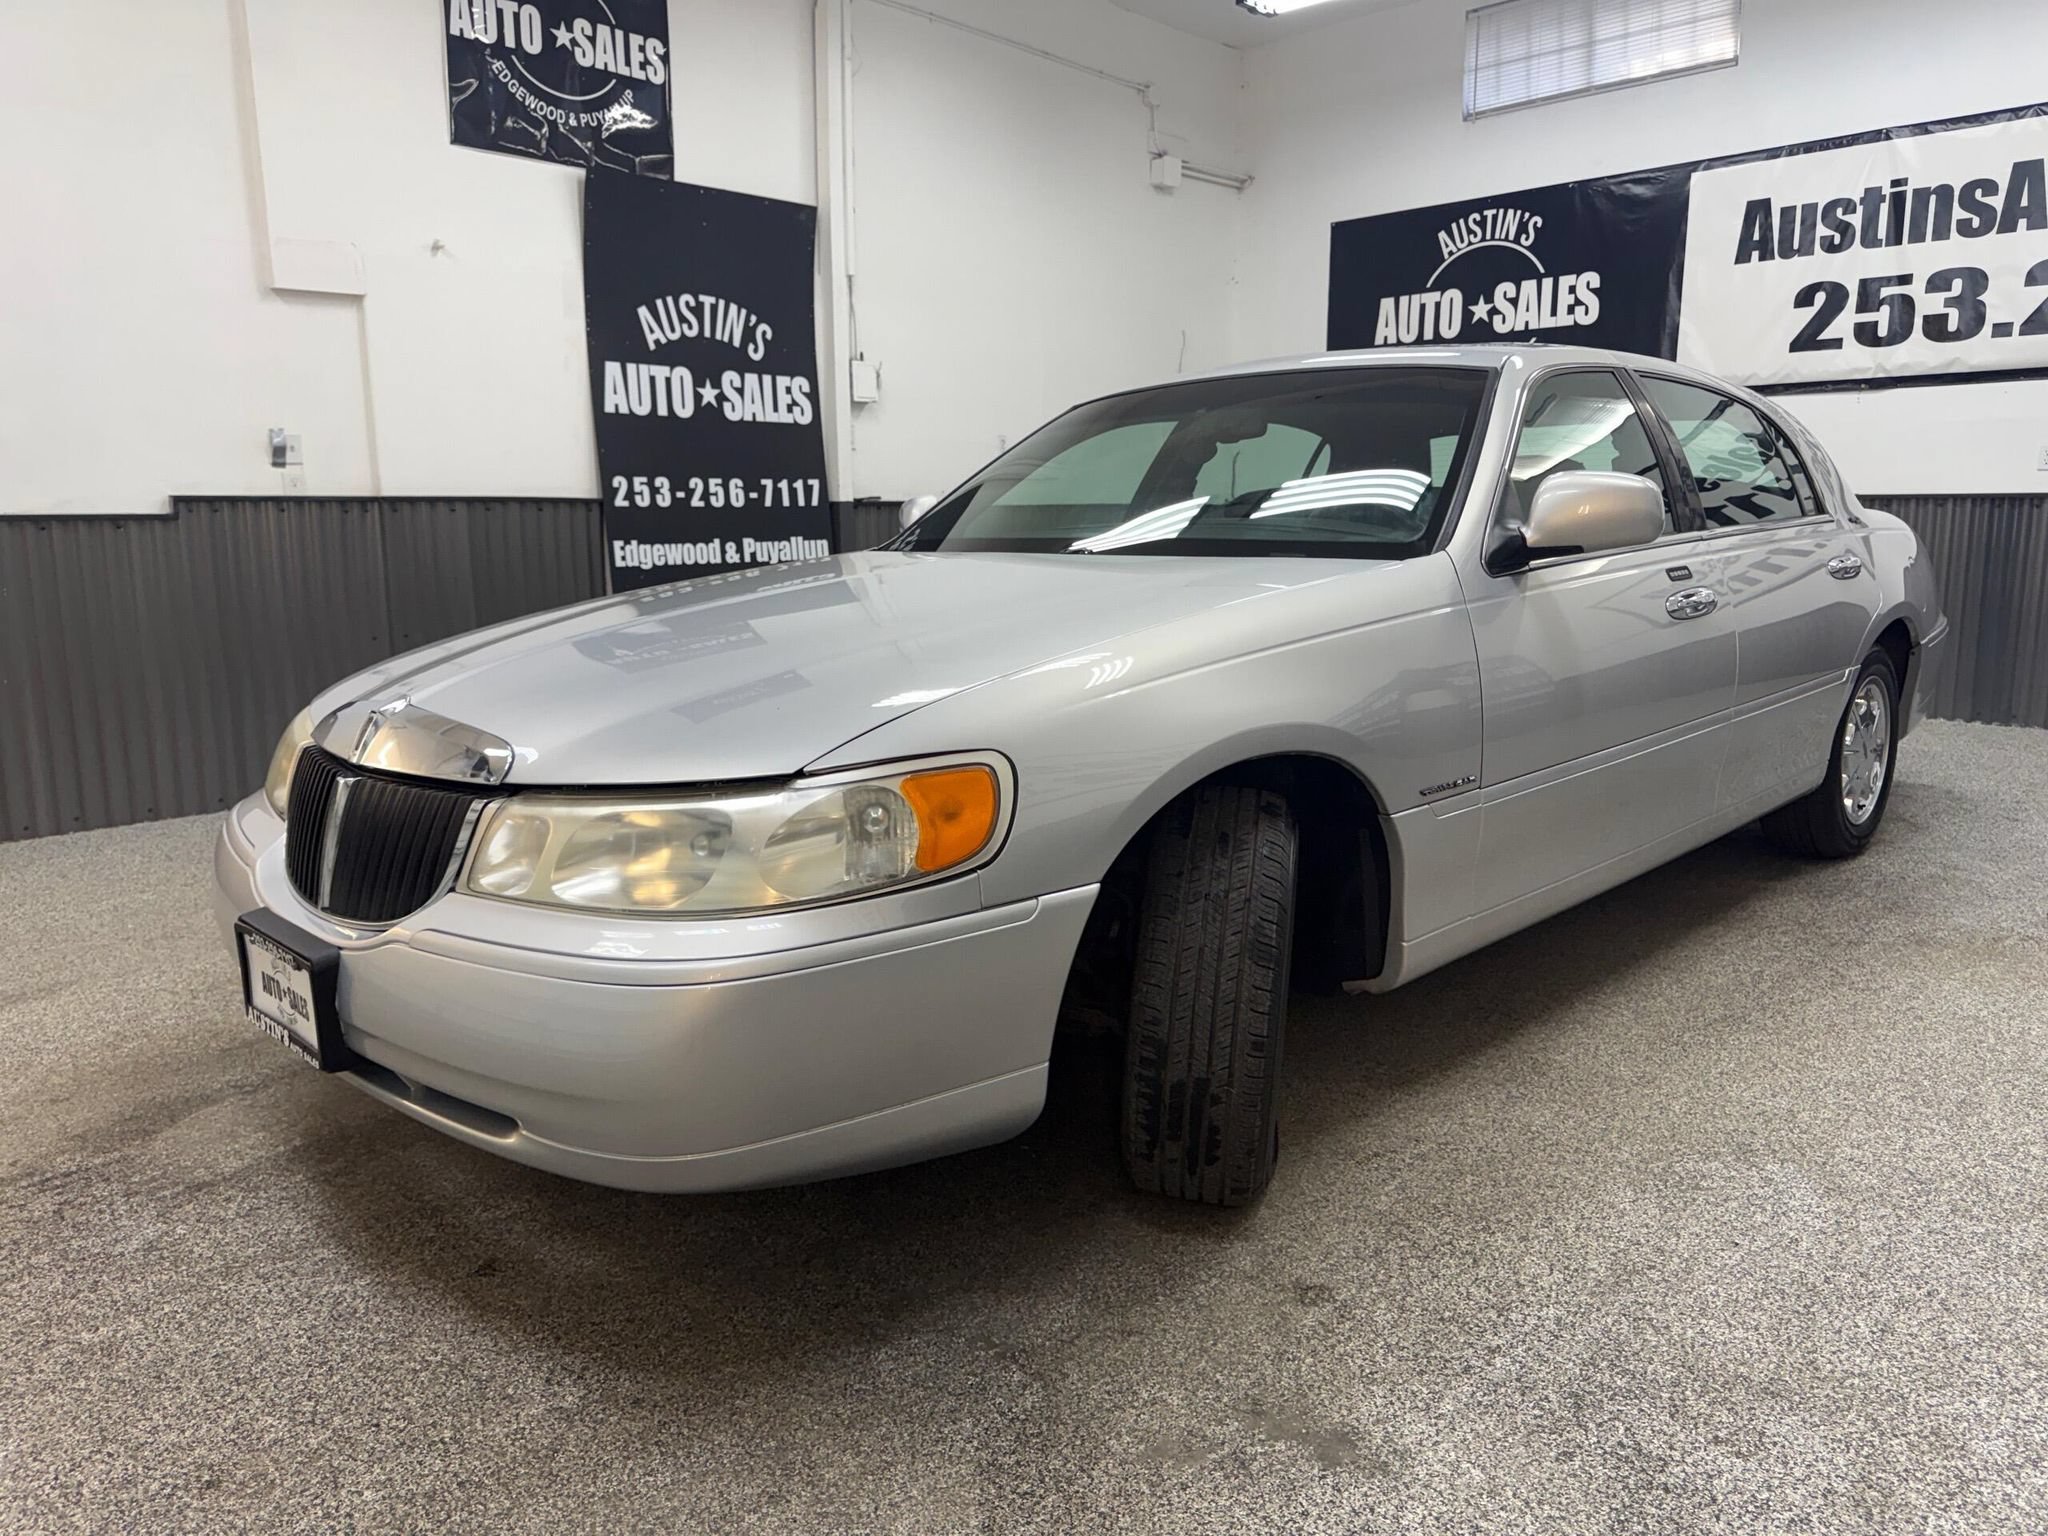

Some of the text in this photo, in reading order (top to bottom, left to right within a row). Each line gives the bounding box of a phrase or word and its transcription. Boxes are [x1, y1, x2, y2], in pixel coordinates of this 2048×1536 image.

[449, 0, 666, 85] AUTO SALES
[492, 59, 635, 128] EDGEWOOD & PUYAUP
[1437, 207, 1543, 260] AUSTIN'S
[1734, 158, 2048, 266] AustinsA
[636, 293, 773, 362] AUSTIN'S
[1374, 270, 1601, 346] AUTO SALES
[603, 360, 814, 425] AUTO SALES
[612, 475, 821, 508] 253-256-7117
[612, 538, 723, 570] Edgewood
[724, 540, 741, 564] &
[261, 970, 284, 1003] AUTO
